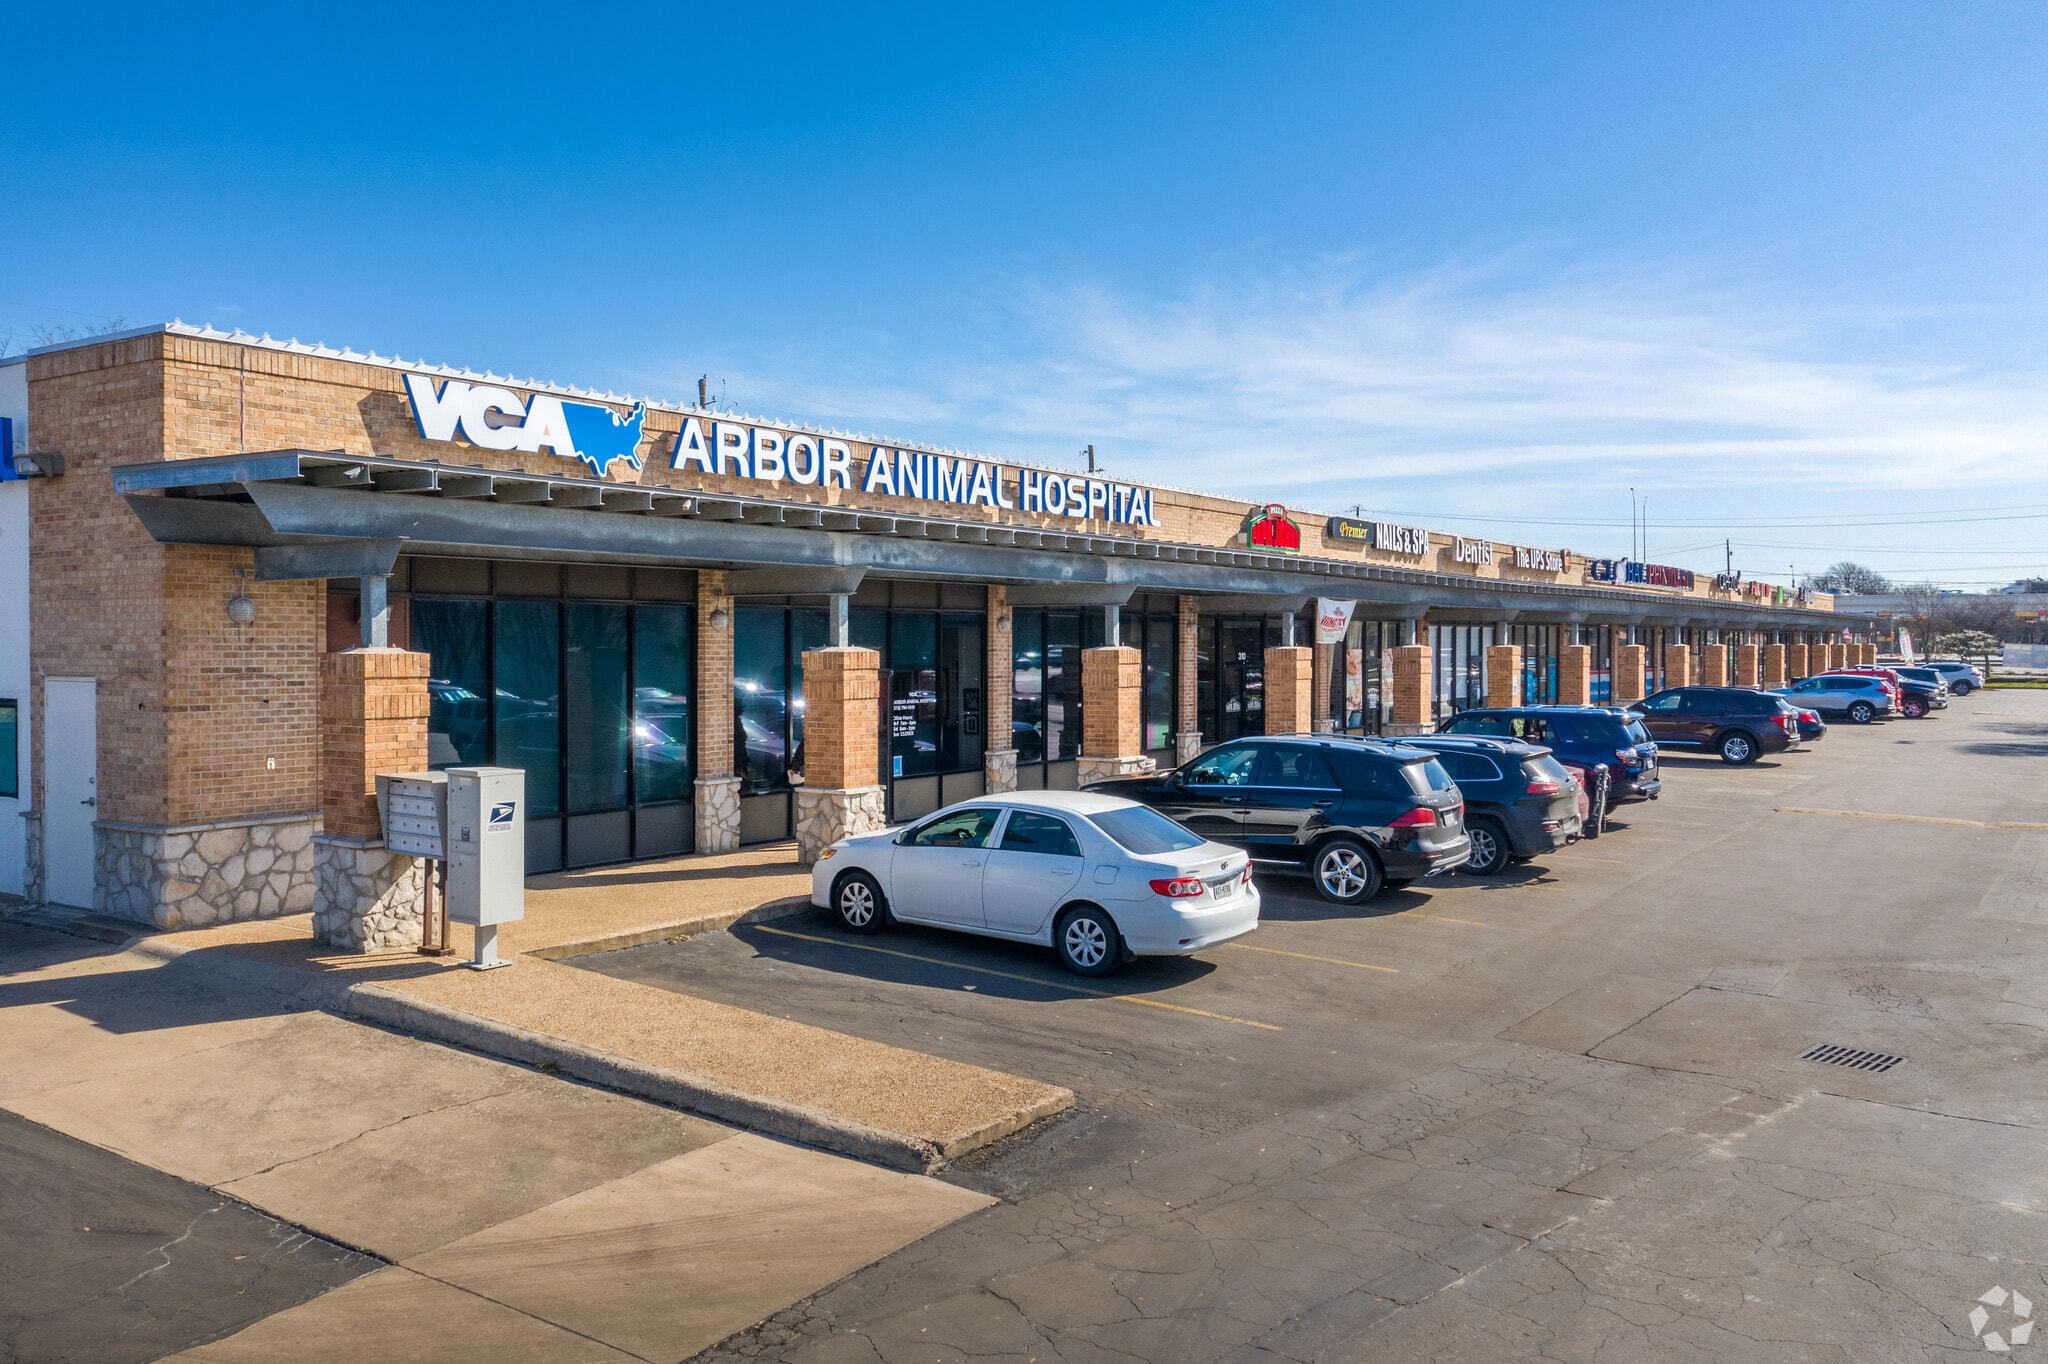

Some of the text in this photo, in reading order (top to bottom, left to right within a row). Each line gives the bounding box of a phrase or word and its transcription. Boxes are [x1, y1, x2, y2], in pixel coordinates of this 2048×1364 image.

[402, 373, 579, 457] VCA
[669, 417, 1162, 527] ARBOR ANIMAL HOSPITAL
[1339, 521, 1369, 539] Premier
[1376, 523, 1430, 555] NAILS & SPA
[1456, 537, 1494, 566] Dentist
[1516, 547, 1563, 572] The UPS Store
